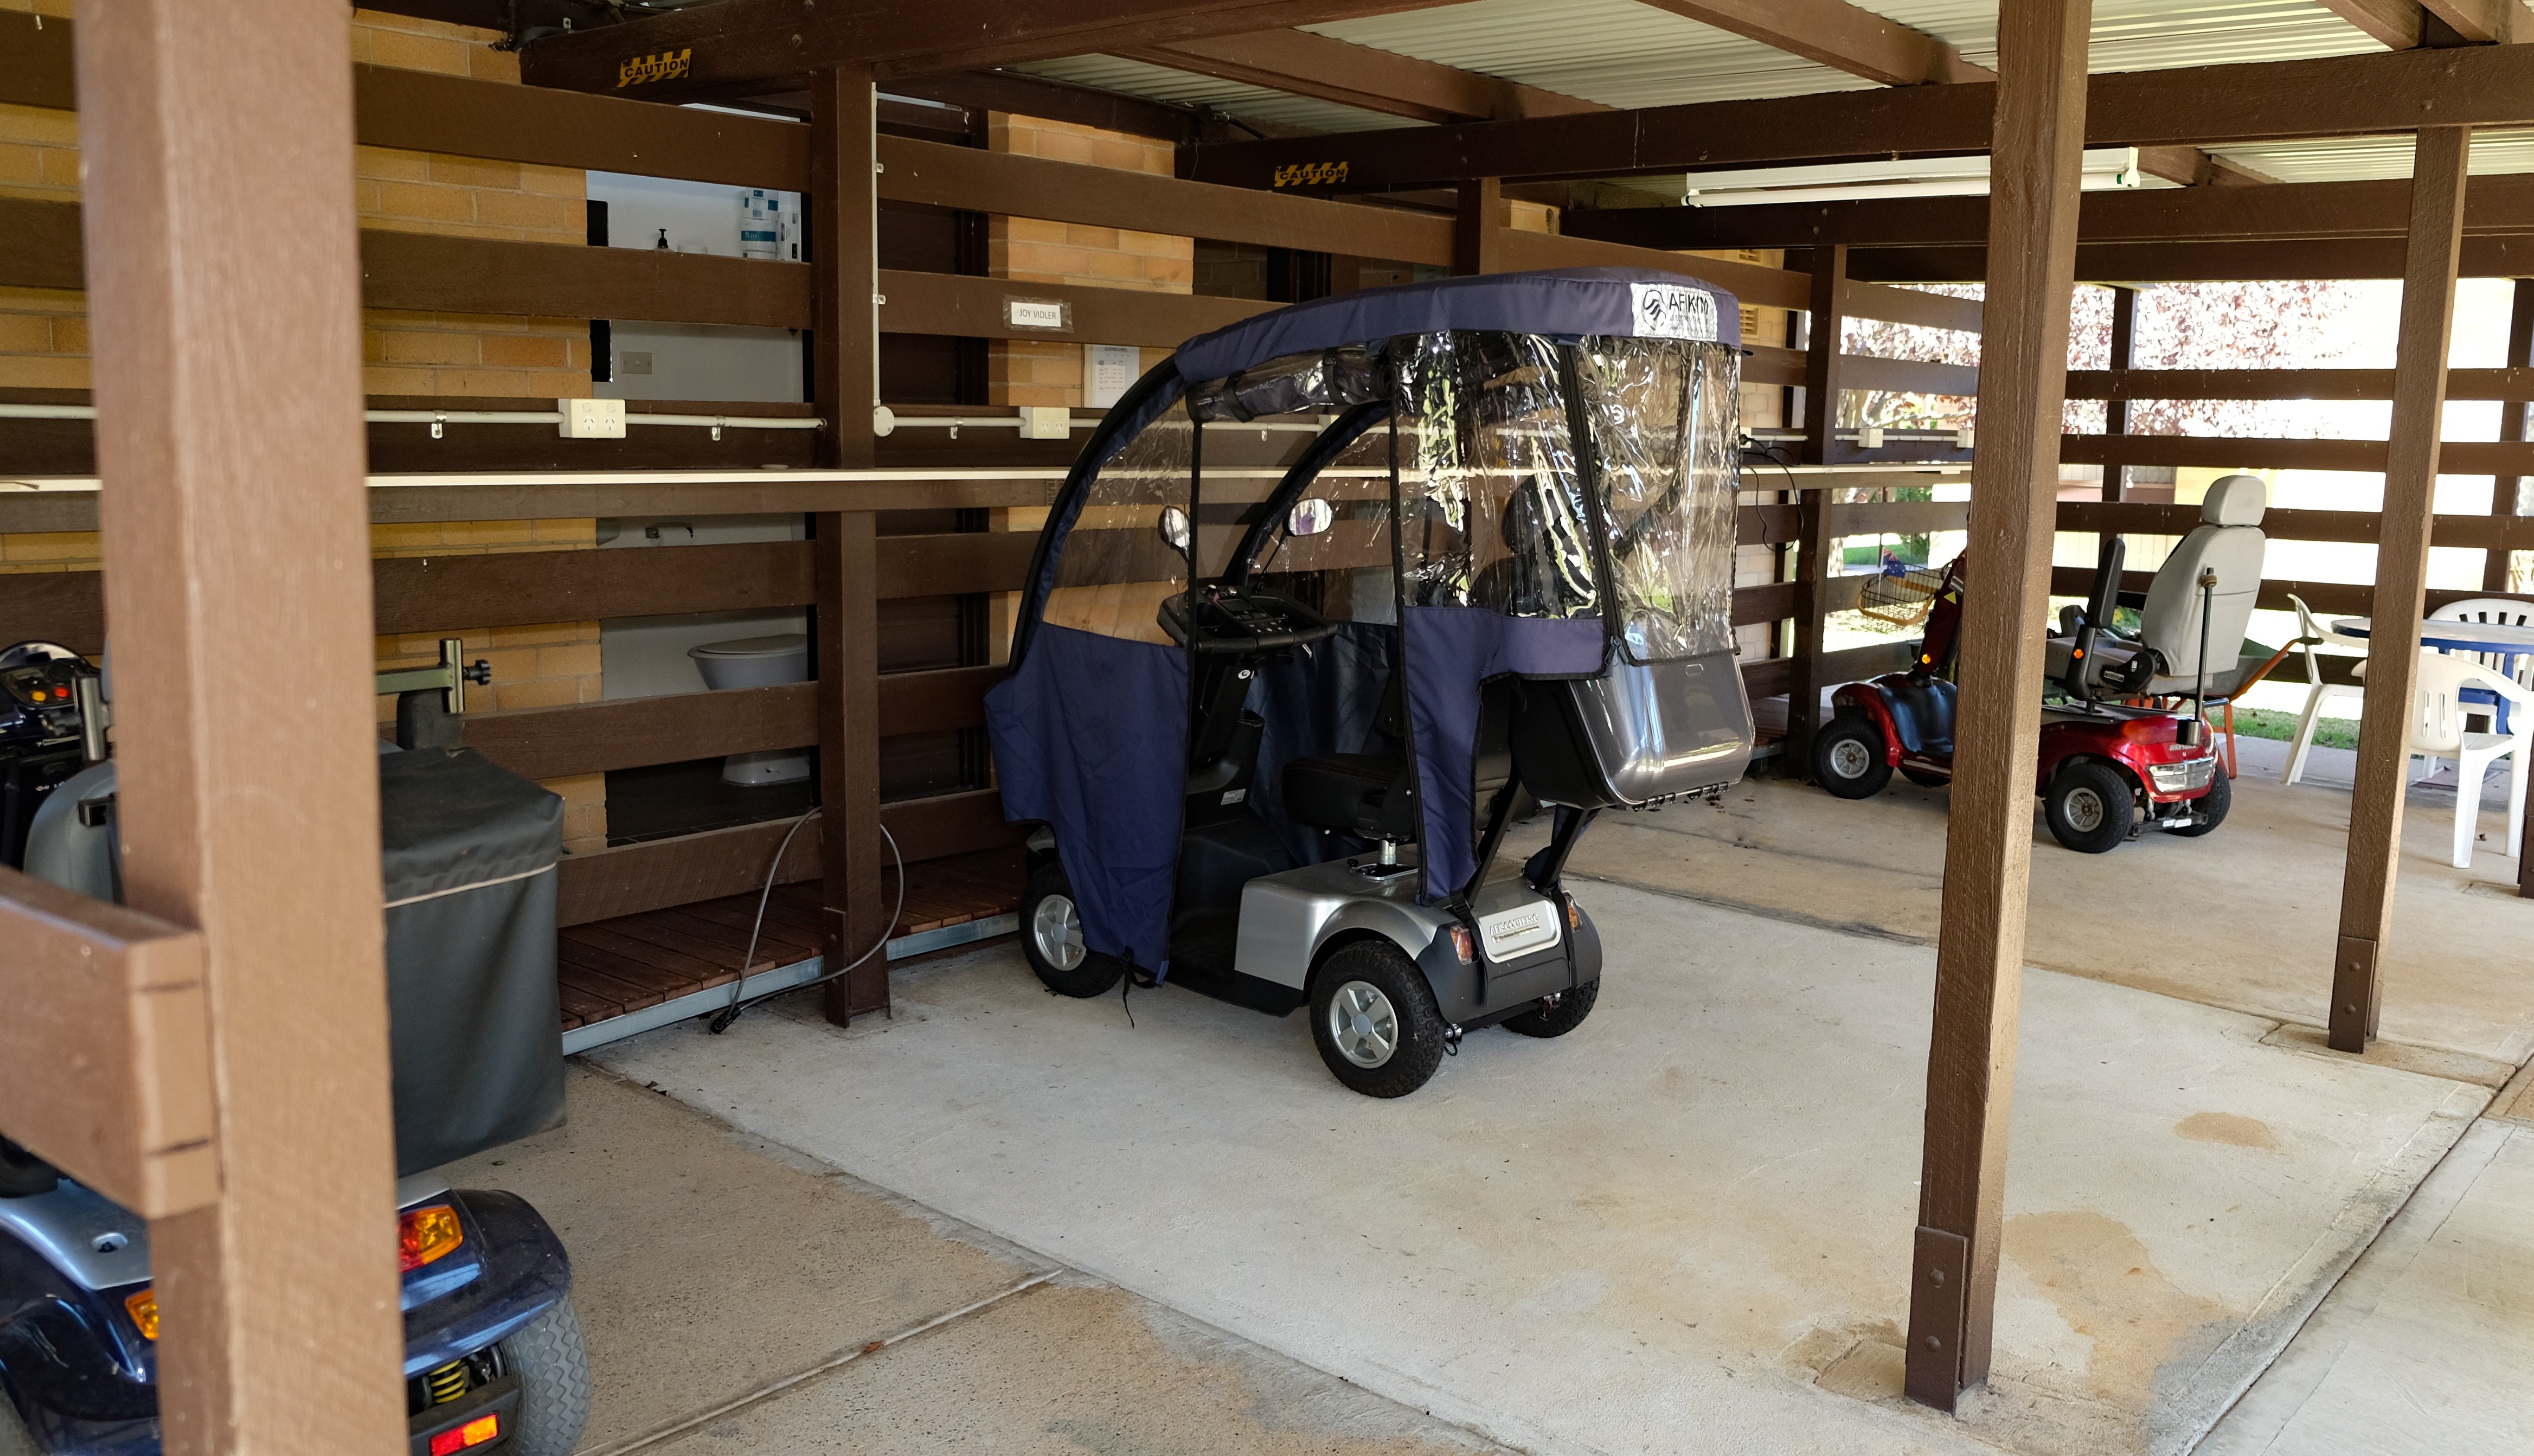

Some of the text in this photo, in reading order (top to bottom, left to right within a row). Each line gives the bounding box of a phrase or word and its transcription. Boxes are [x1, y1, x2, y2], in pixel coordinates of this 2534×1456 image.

[625, 58, 688, 78] CAUTION
[1280, 169, 1345, 180] CAUTION
[1019, 309, 1057, 319] JOY VIDLER
